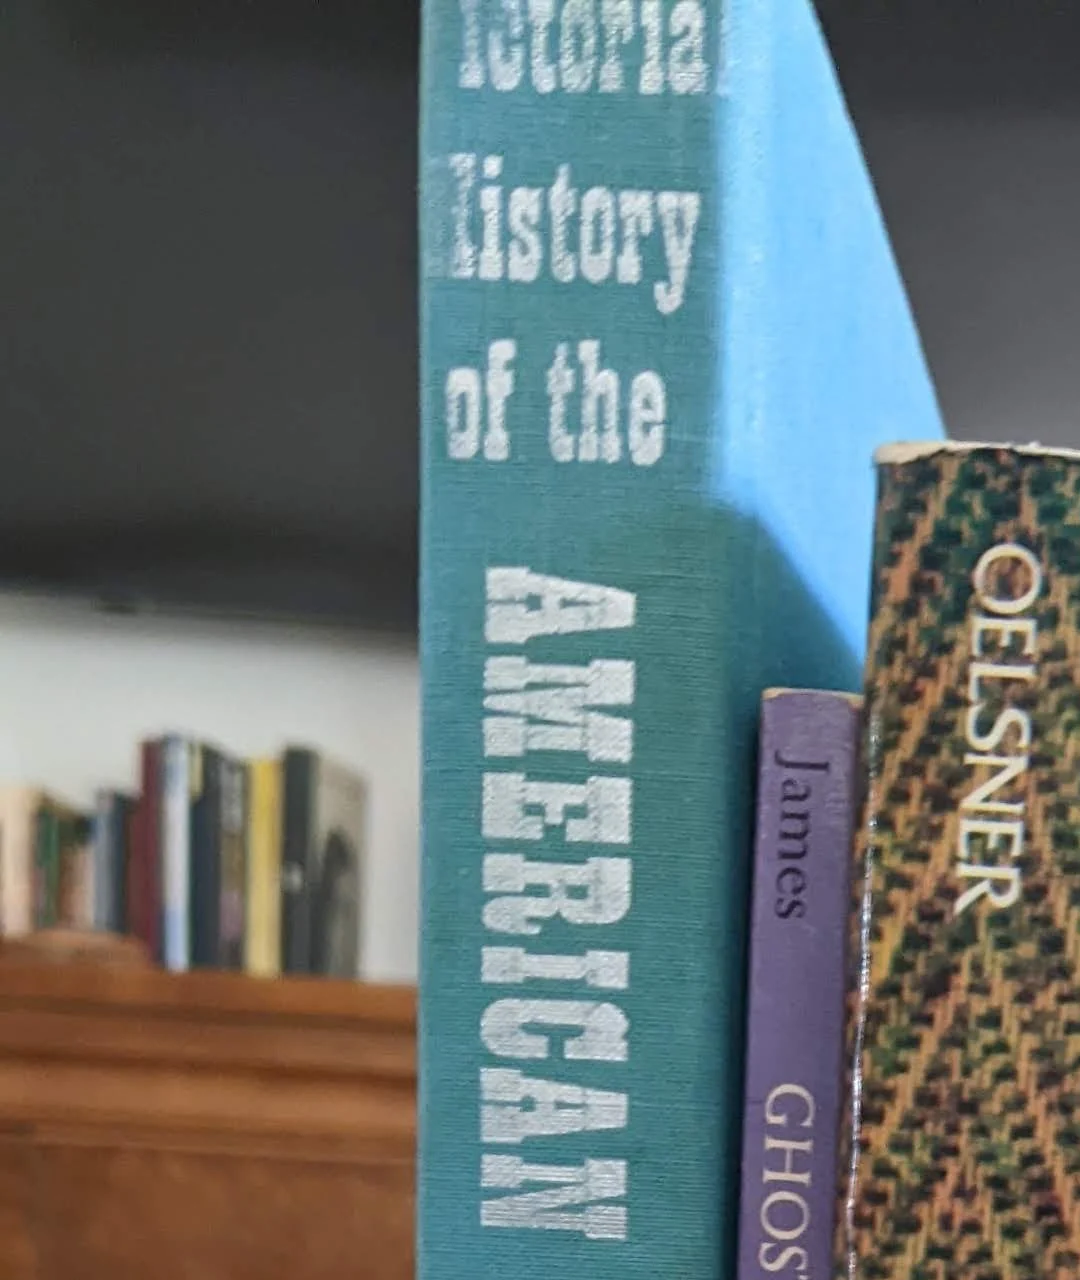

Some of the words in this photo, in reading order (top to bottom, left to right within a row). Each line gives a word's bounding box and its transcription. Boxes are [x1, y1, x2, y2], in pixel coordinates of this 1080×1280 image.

[456, 0, 709, 95] ictoria
[445, 338, 517, 461] of
[546, 338, 667, 466] the
[954, 543, 1043, 913] OELSNER
[480, 566, 637, 1242] AMERICAN
[774, 751, 831, 921] James
